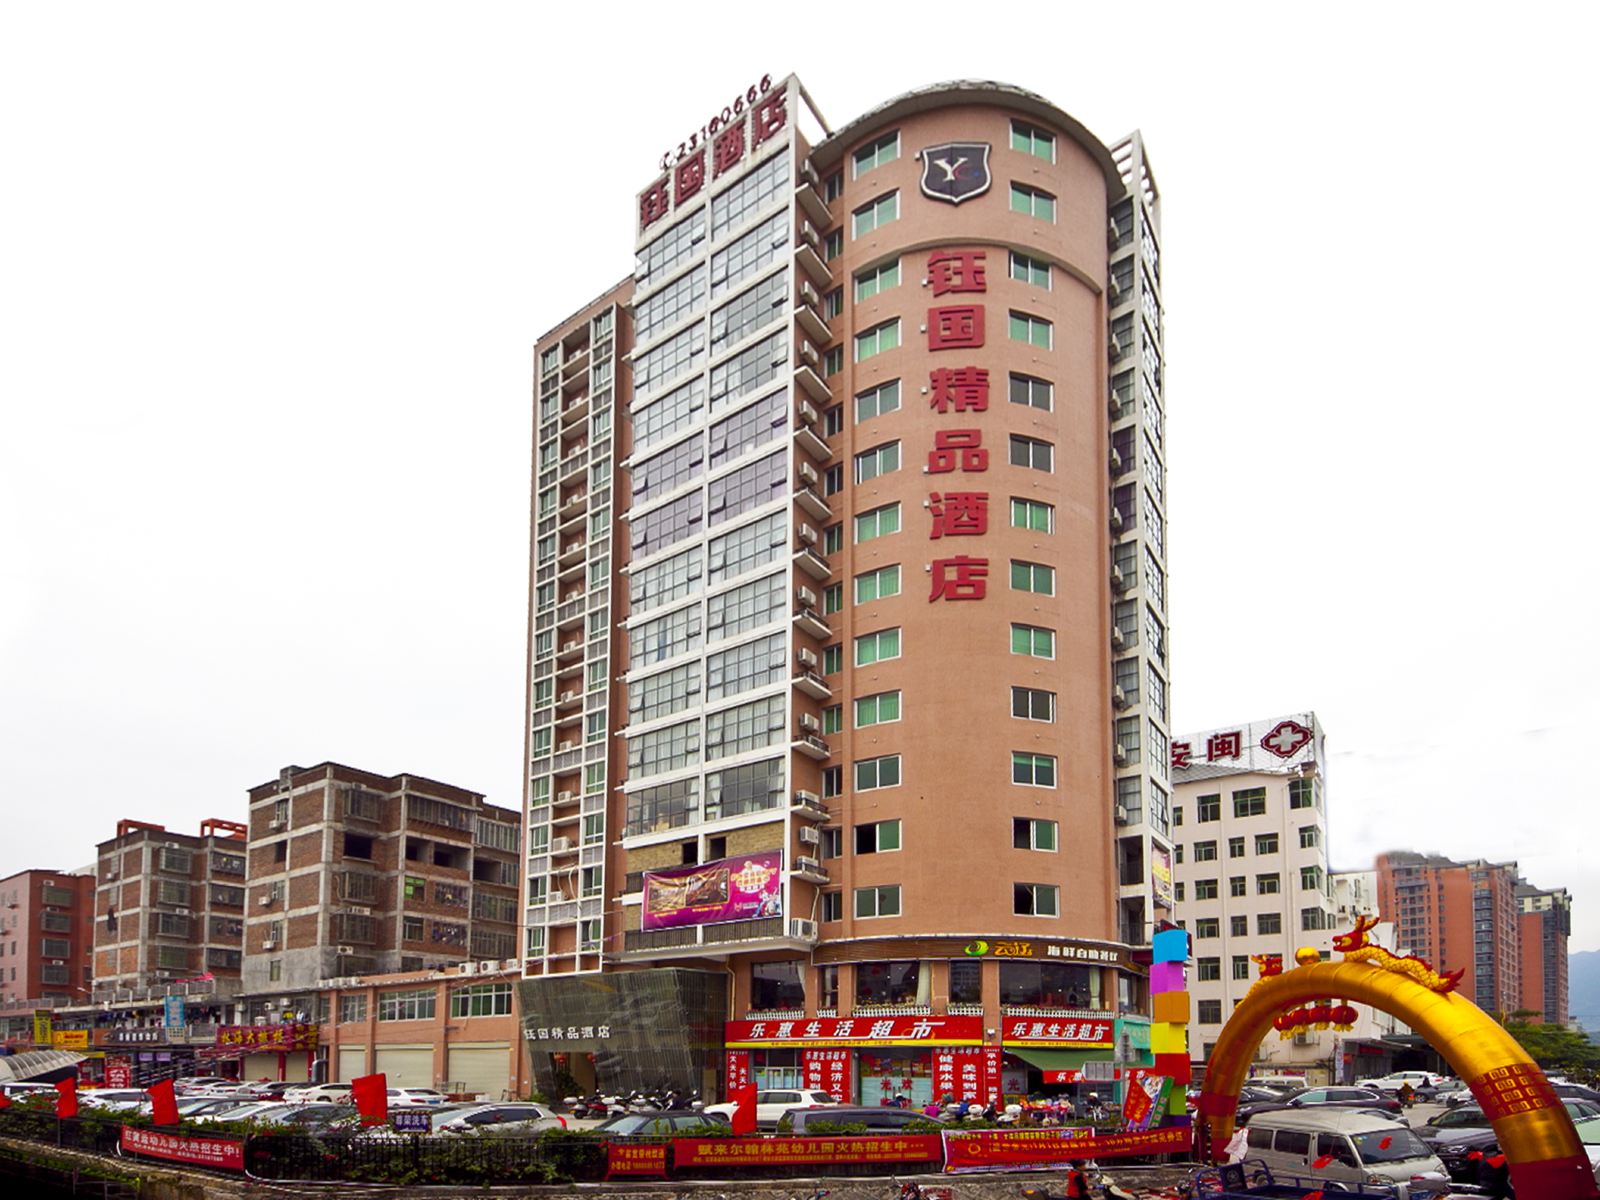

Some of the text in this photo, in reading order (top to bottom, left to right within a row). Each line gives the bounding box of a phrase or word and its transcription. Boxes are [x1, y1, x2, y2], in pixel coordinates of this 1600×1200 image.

[928, 250, 989, 603] 钰国精品酒店
[524, 1026, 611, 1040] 钰国精品酒店
[750, 1018, 946, 1040] 乐惠生活超市
[1011, 1022, 1110, 1041] 乐惠生活超市
[939, 1054, 954, 1090] 健康水果
